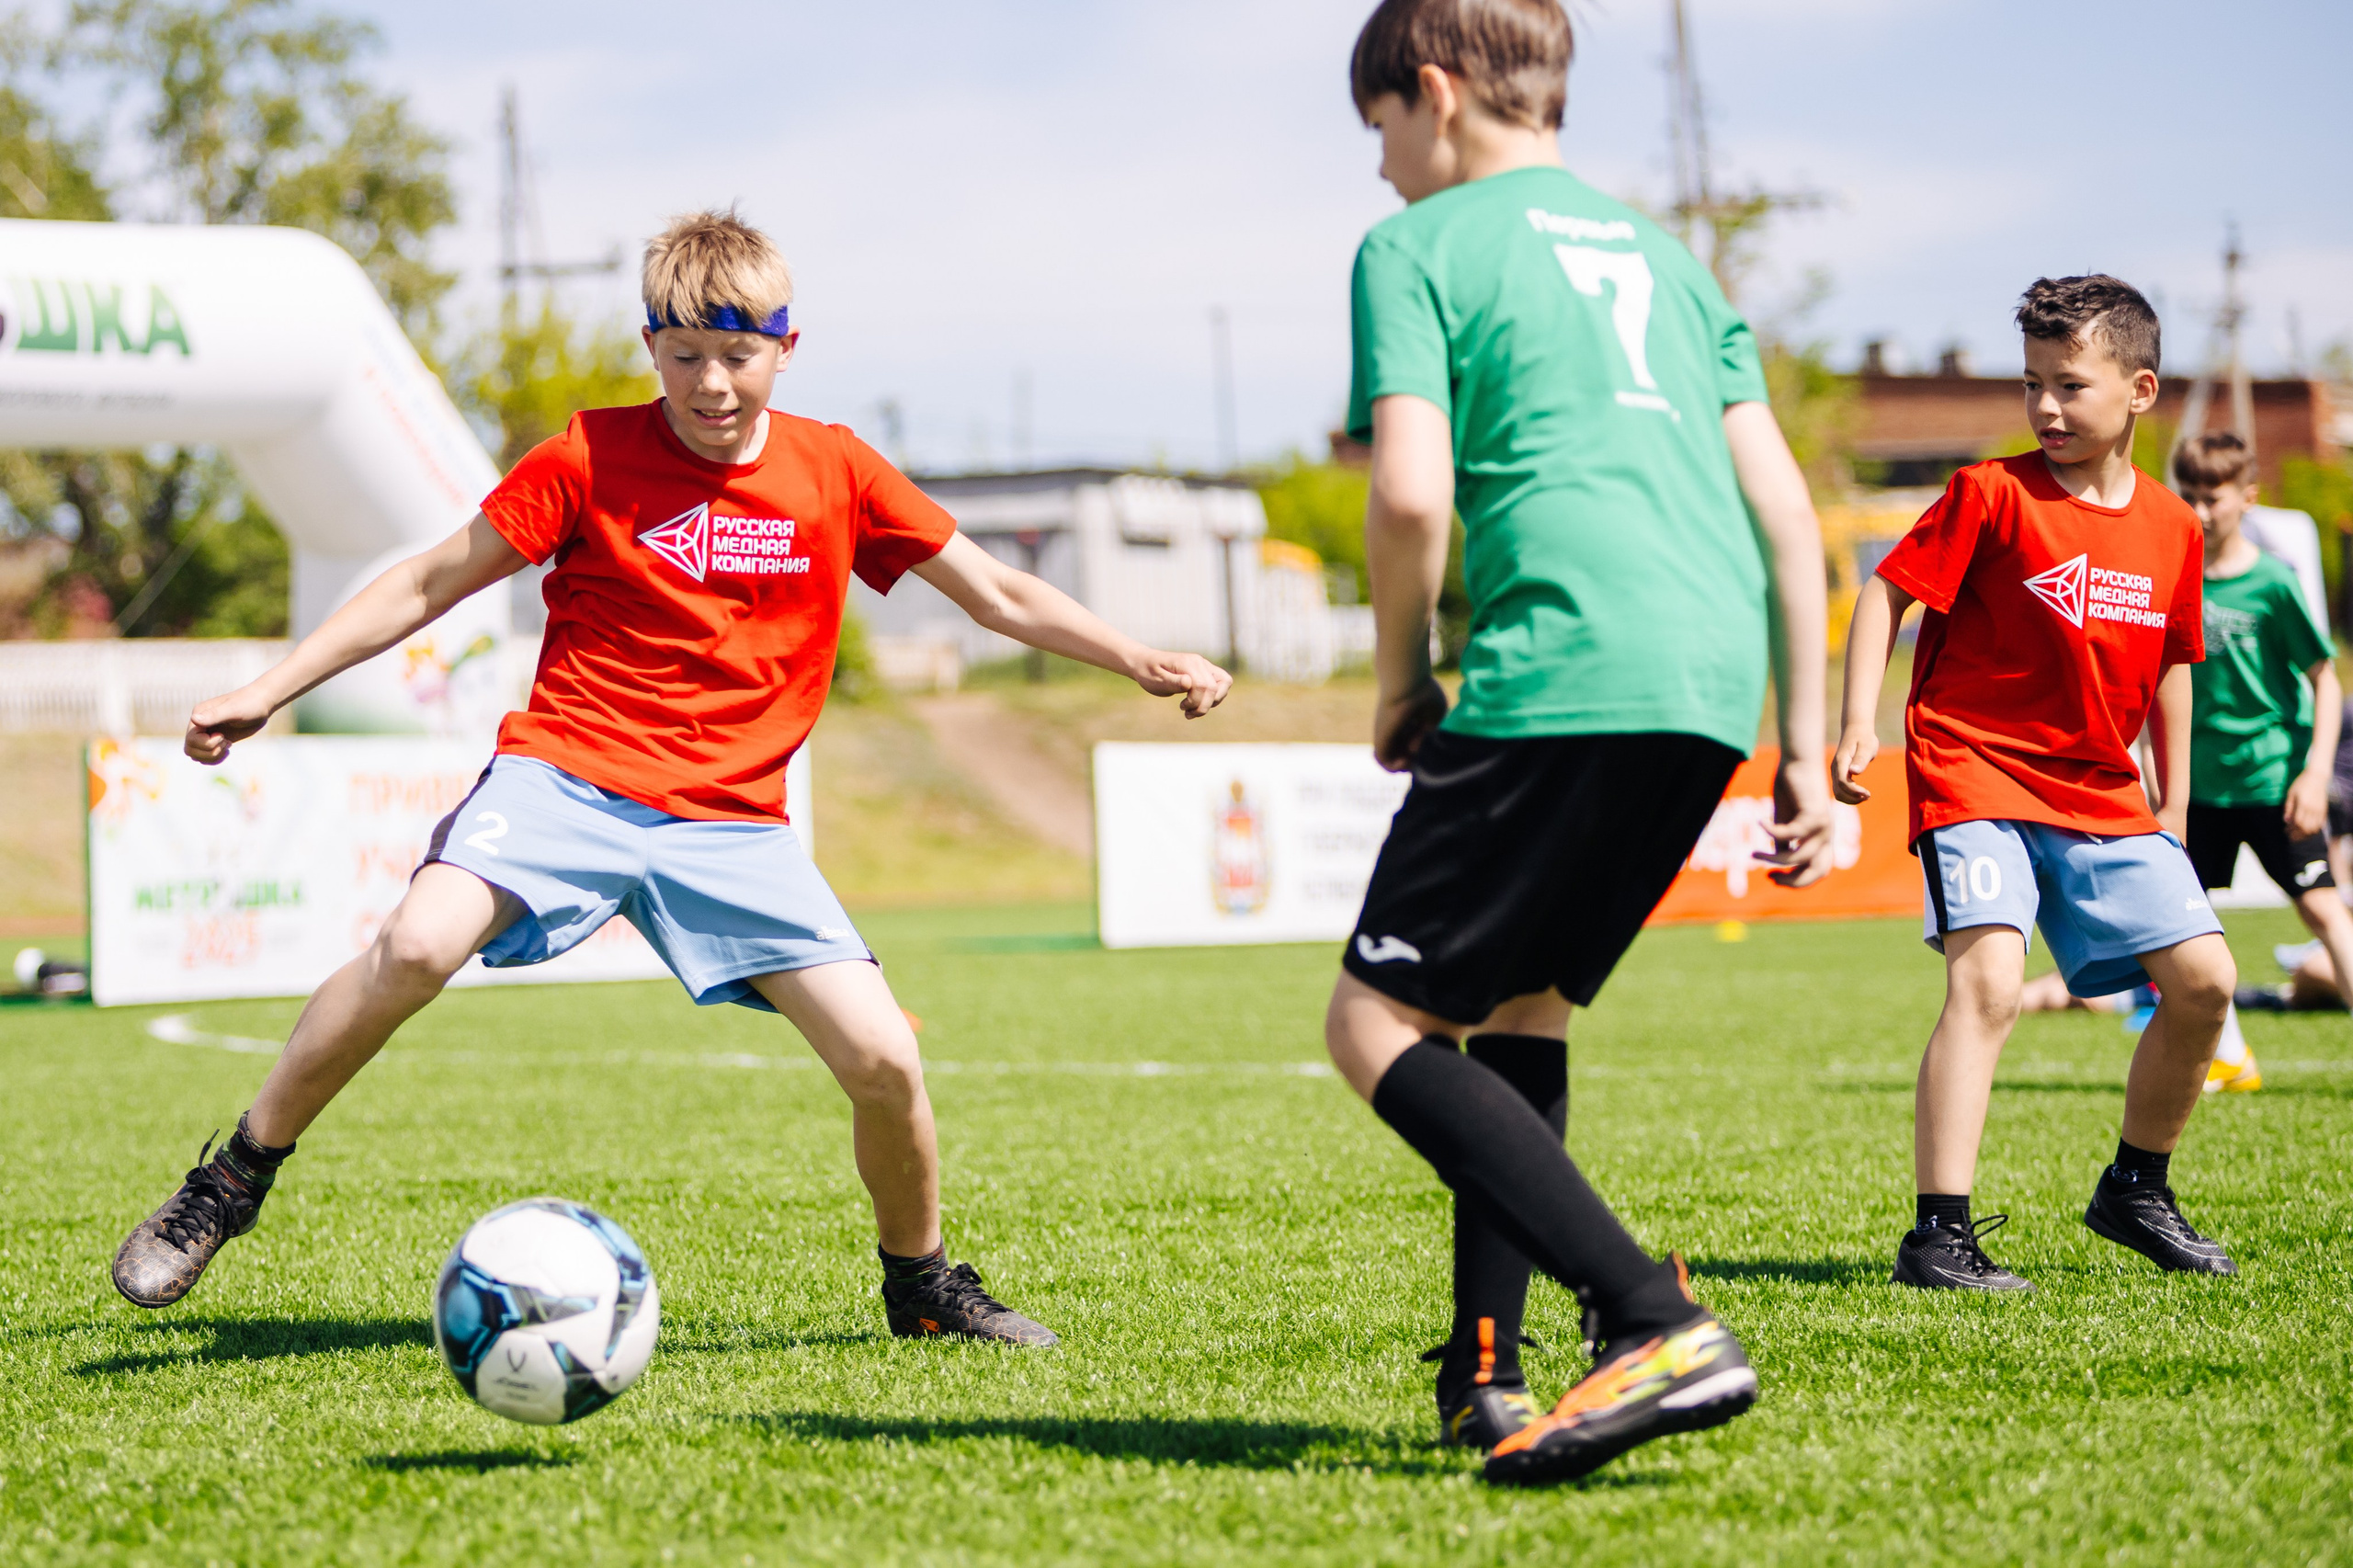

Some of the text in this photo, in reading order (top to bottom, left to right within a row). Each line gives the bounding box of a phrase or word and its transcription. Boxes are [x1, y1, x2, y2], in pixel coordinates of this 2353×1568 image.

[1552, 243, 1657, 390] 7
[712, 516, 795, 538] РУССКАЯ
[712, 536, 791, 556] МЕДНАЯ
[711, 555, 811, 574] КОМПАНИЯ
[2089, 567, 2153, 593] РУССКАЯ
[2089, 585, 2151, 609] МЕДНАЯ
[2087, 603, 2166, 630] КОМПАНИЯ
[464, 811, 509, 856] 2
[1949, 855, 2002, 904] 10
